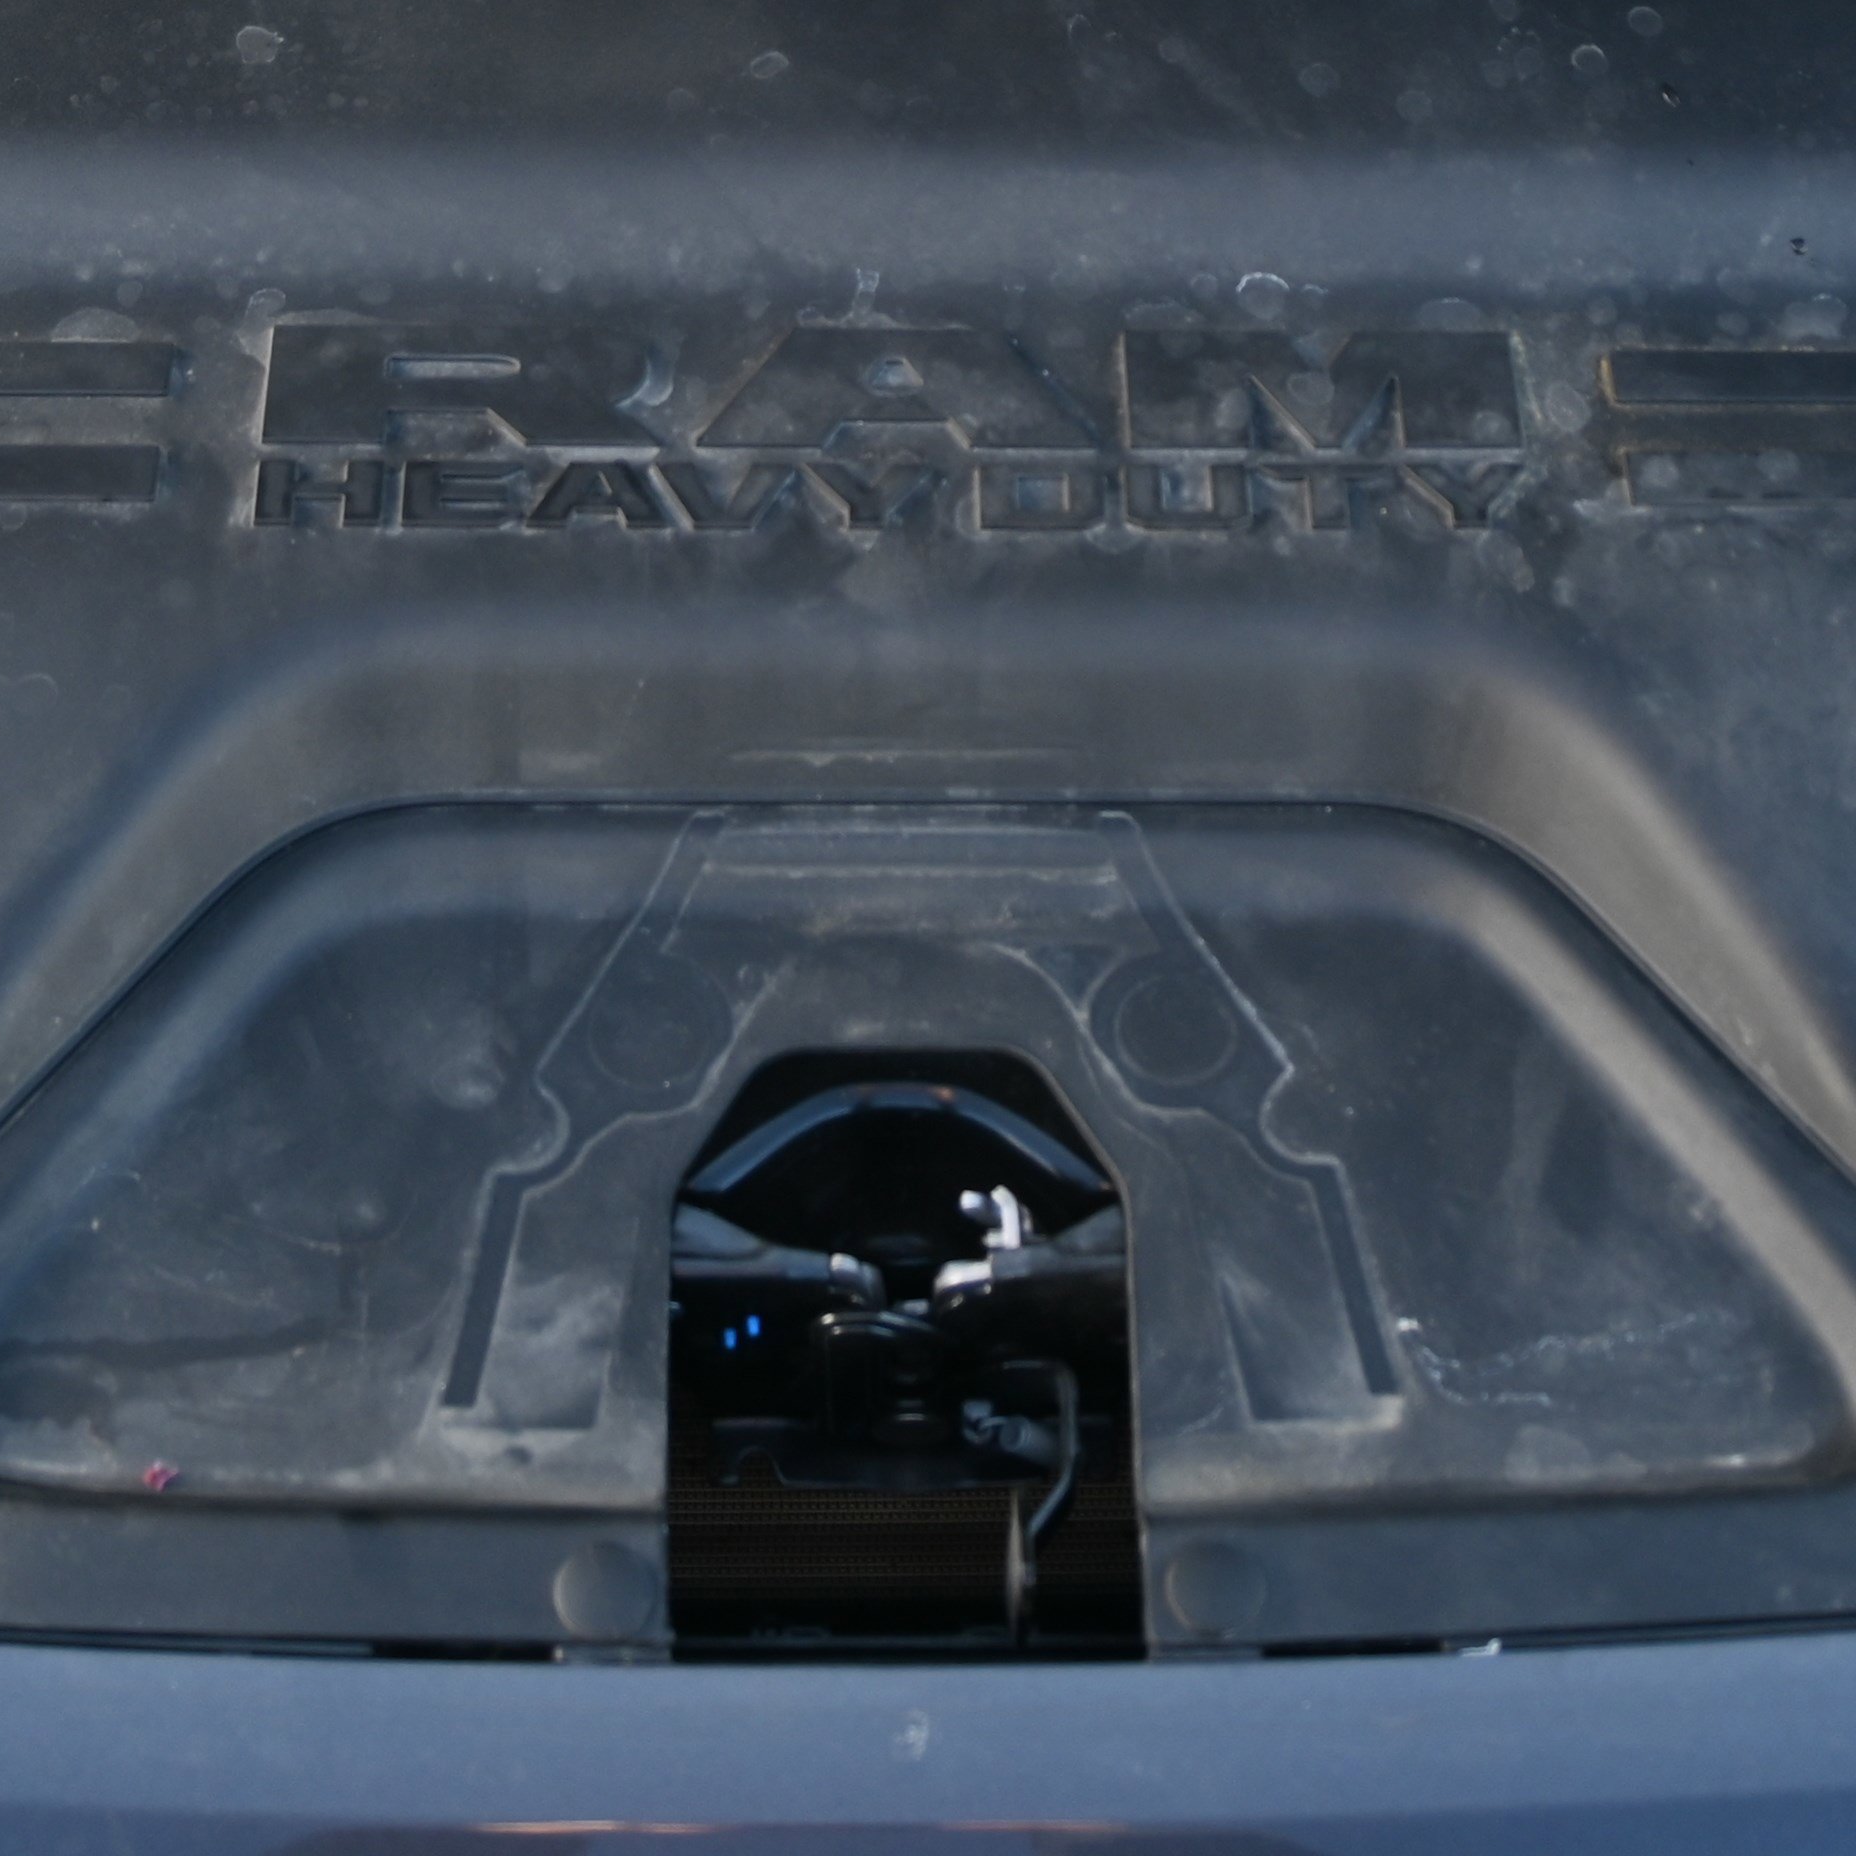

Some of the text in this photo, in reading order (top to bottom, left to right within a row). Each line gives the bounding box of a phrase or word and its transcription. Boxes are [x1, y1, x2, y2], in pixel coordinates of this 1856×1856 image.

[261, 322, 1524, 451] RAM
[254, 458, 1528, 531] HEAVY DUTY
